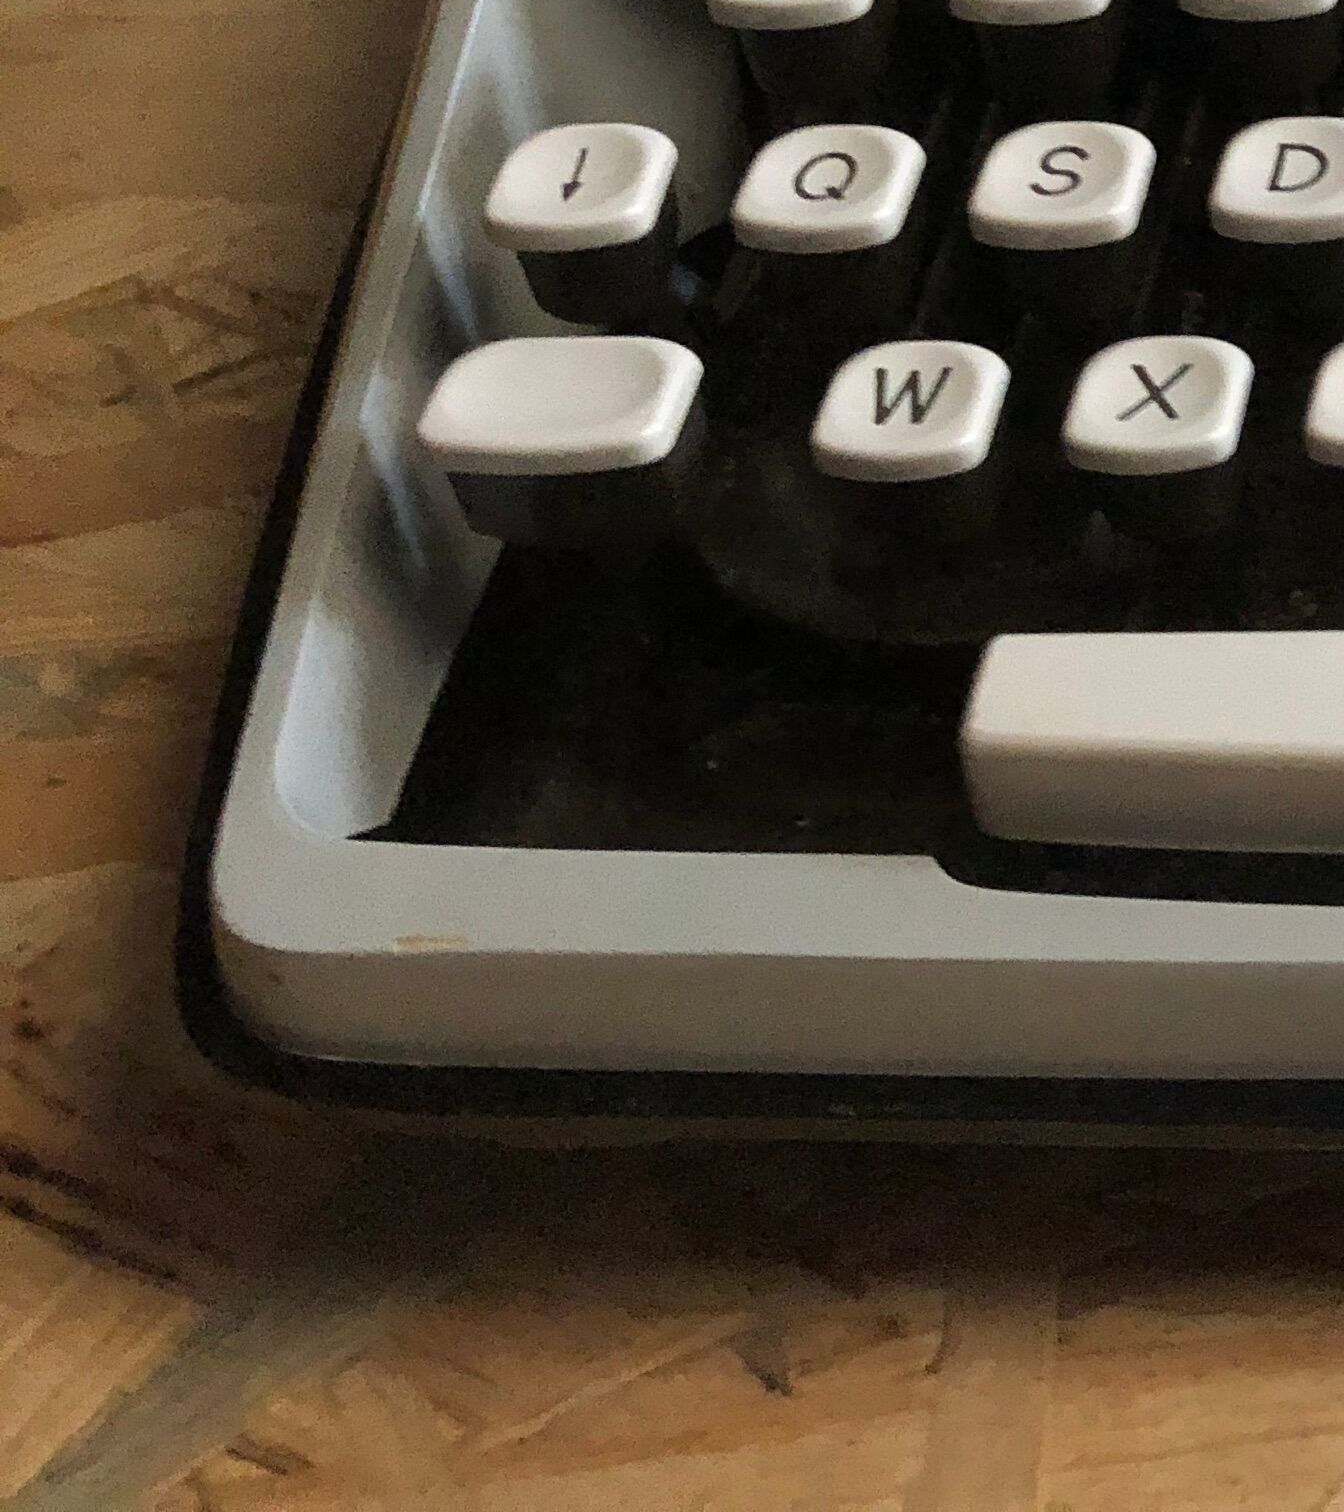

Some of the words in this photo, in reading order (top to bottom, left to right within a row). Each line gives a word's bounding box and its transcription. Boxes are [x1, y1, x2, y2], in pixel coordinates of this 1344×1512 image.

[793, 151, 858, 201] Q
[1028, 145, 1090, 197] S
[1266, 142, 1329, 193] D
[873, 366, 953, 426] W
[1117, 363, 1192, 421] X
